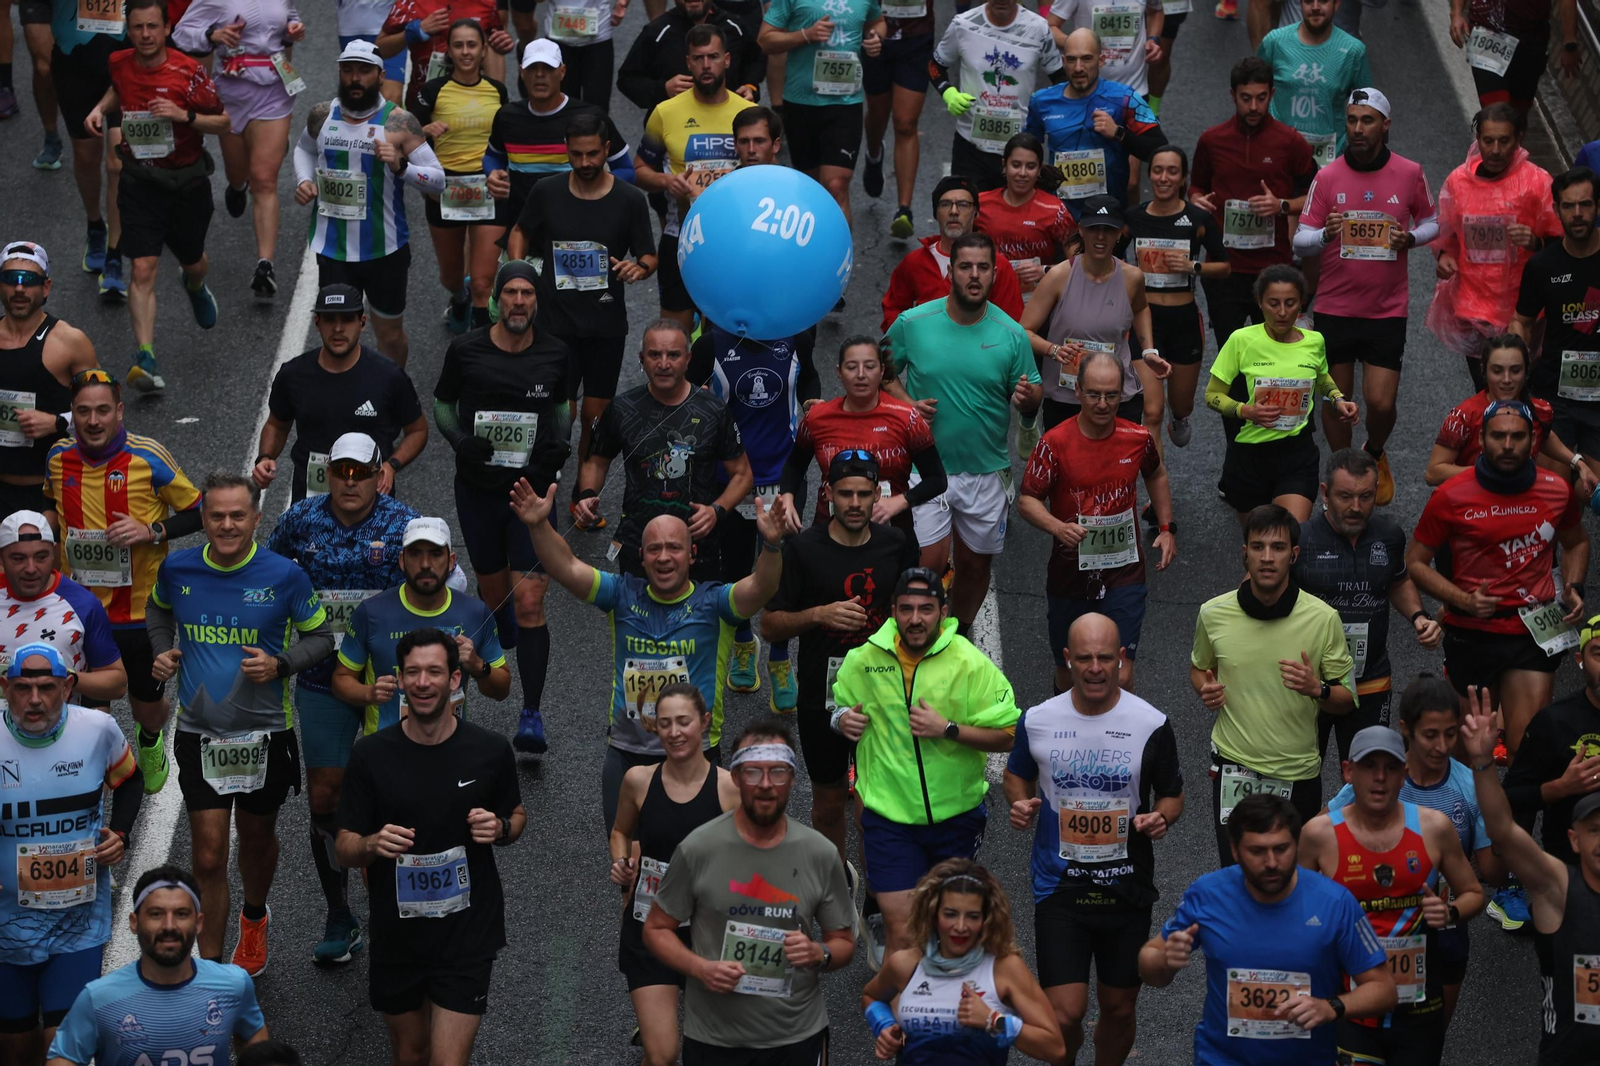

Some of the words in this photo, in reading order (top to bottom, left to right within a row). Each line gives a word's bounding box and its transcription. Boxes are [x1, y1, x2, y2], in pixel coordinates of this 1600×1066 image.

[86, 0, 117, 13] 6121
[1100, 16, 1131, 30] 8415
[822, 61, 852, 76] 7557
[128, 124, 160, 138] 9302
[979, 118, 1011, 134] 8385
[324, 181, 353, 198] 8802
[750, 197, 816, 247] 2:00
[1350, 223, 1385, 238] 5657
[560, 254, 594, 269] 2851
[485, 426, 523, 444] 7826
[1491, 506, 1538, 517] RUNNERS
[1089, 526, 1125, 546] 7116
[1499, 530, 1540, 556] YAK
[73, 543, 114, 562] 6896
[1338, 581, 1372, 592] TRAIL
[201, 614, 208, 624] C
[216, 615, 222, 625] D
[231, 616, 238, 626] C
[184, 623, 259, 646] TUSSAM
[625, 636, 697, 656] TUSSAM
[208, 747, 260, 767] 10399
[1049, 749, 1132, 764] RUNNERS
[1, 760, 20, 785] Ñ
[1053, 764, 1066, 779] la
[1069, 753, 1131, 778] Palmera
[1068, 814, 1112, 834] 4908
[30, 857, 80, 881] 6304
[407, 868, 453, 890] 1962
[734, 940, 782, 968] 8144
